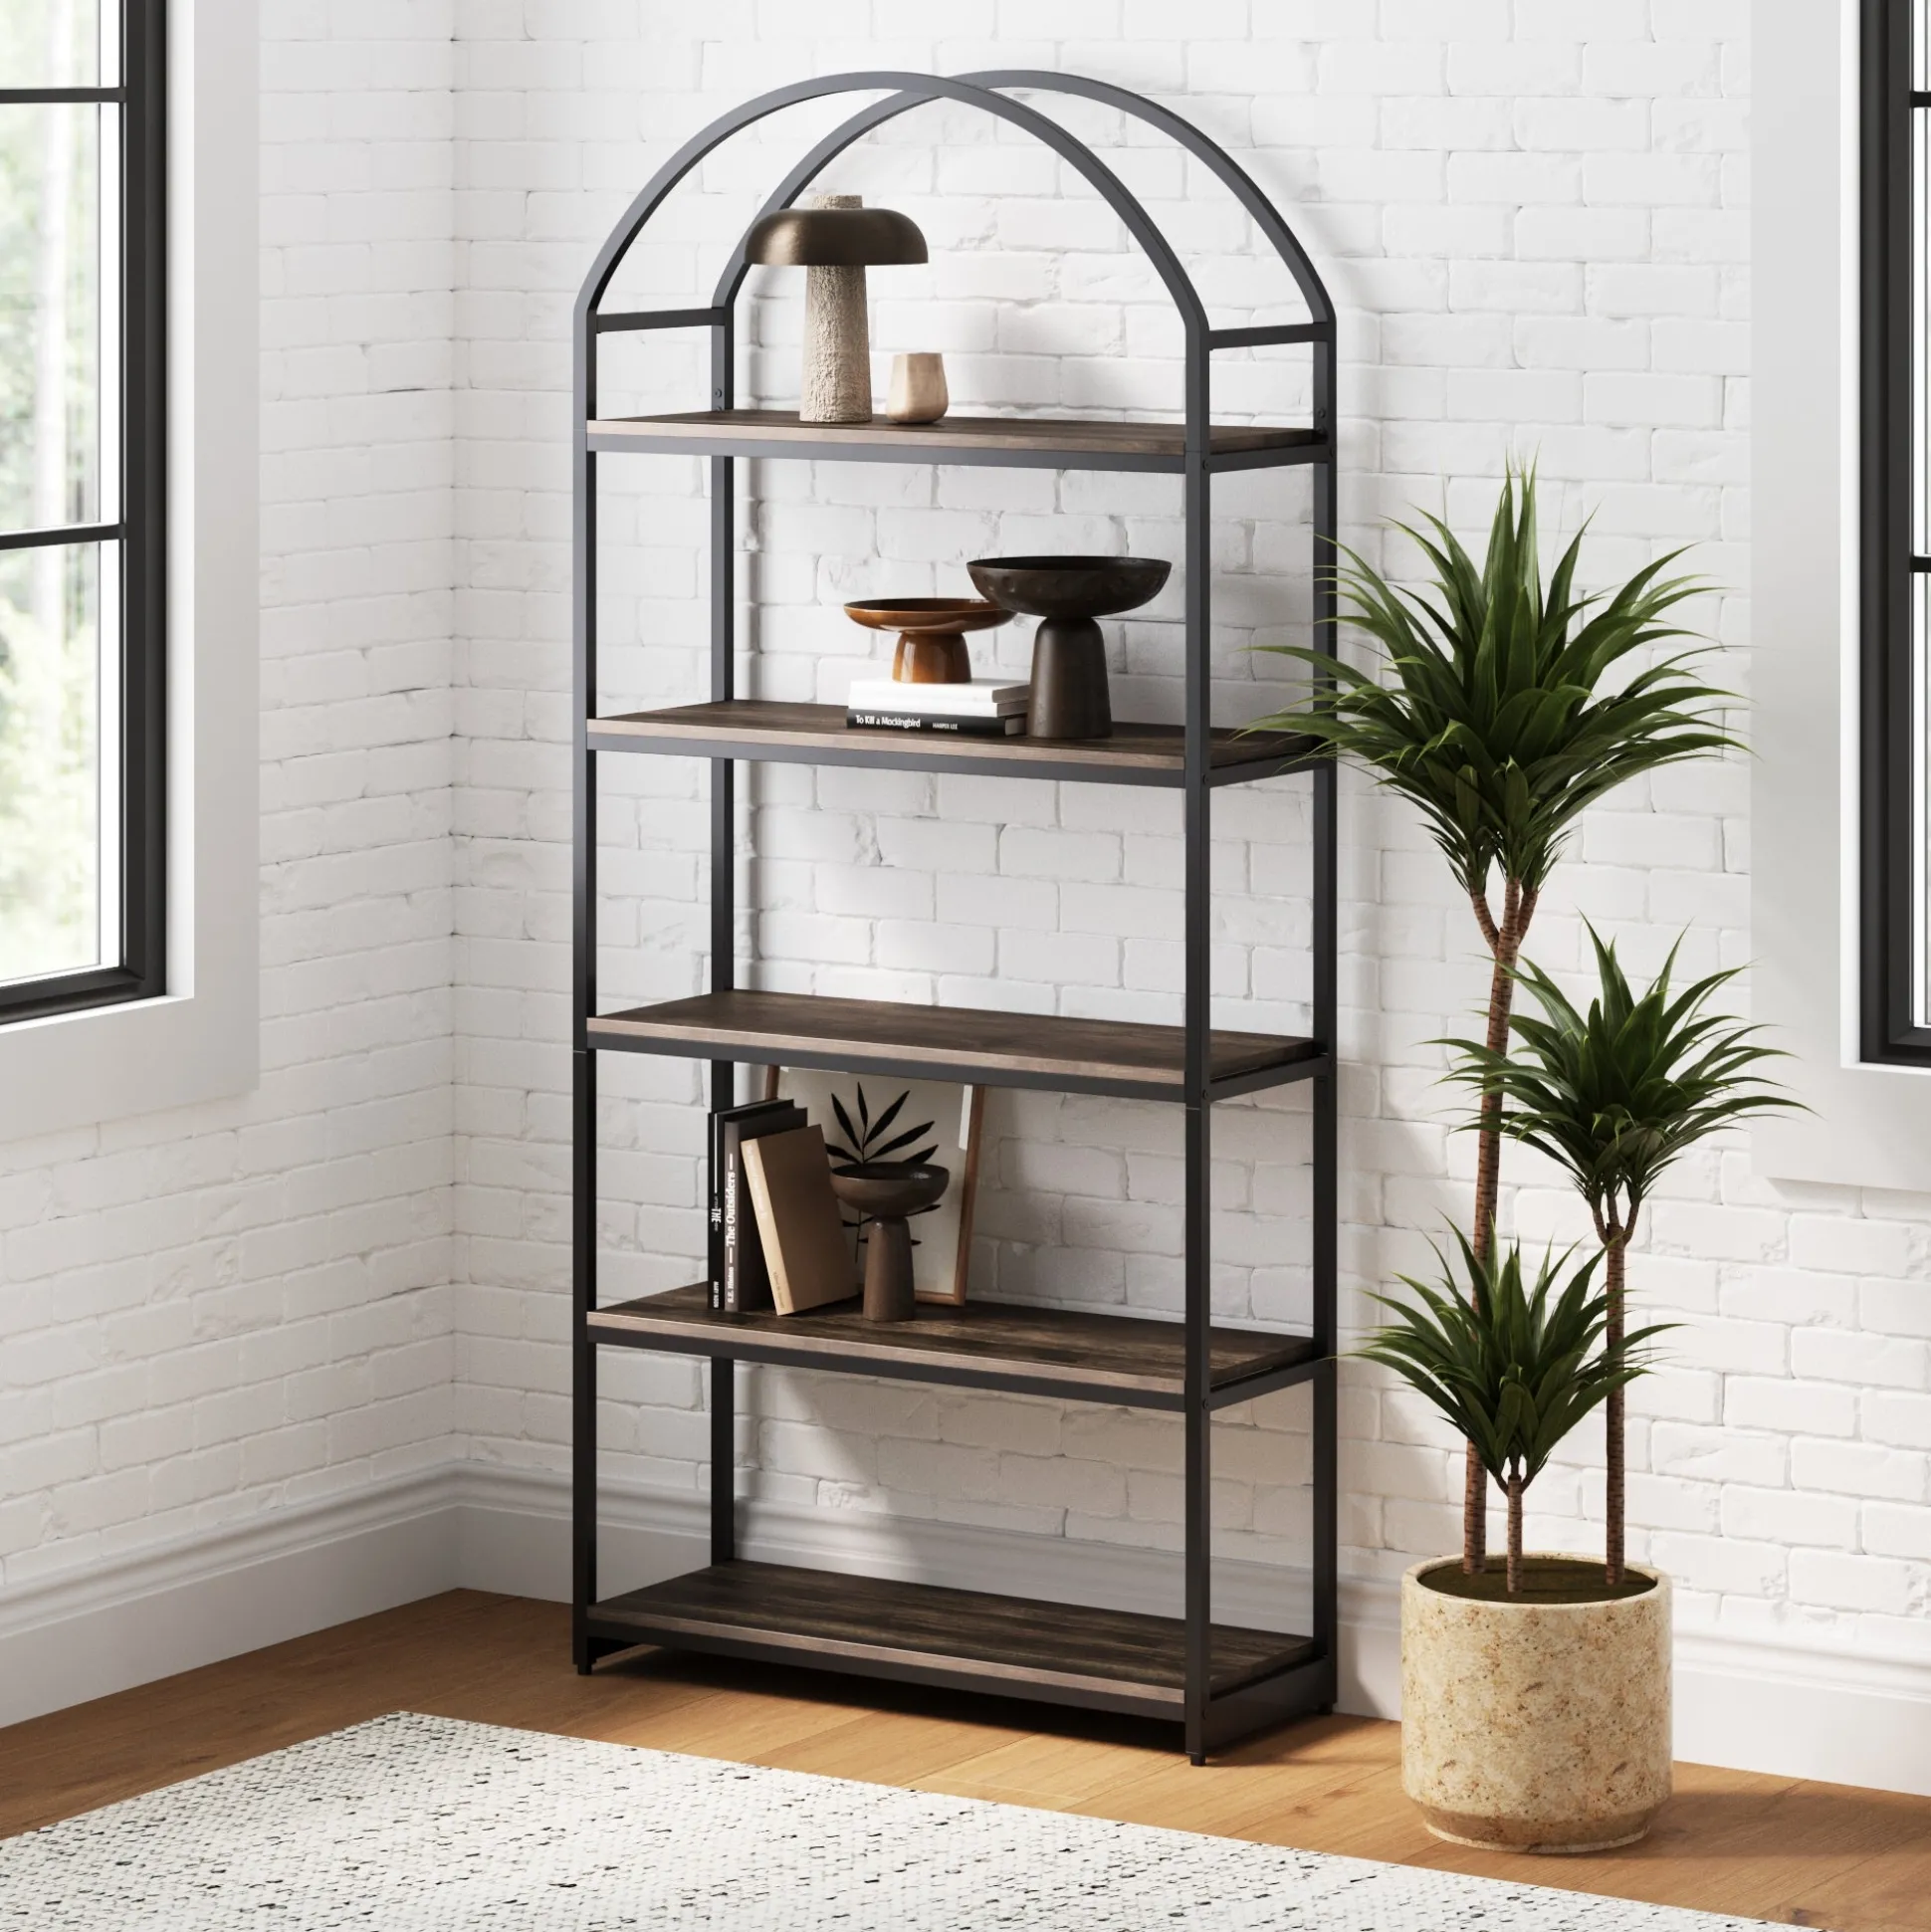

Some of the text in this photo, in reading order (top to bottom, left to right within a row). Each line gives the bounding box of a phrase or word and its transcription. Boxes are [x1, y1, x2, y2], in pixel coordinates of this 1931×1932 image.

[855, 715, 864, 724] To
[865, 716, 875, 725] Kill
[881, 717, 921, 729] Mockingbird
[711, 1207, 722, 1223] THE
[726, 1172, 736, 1247] The Outsiders
